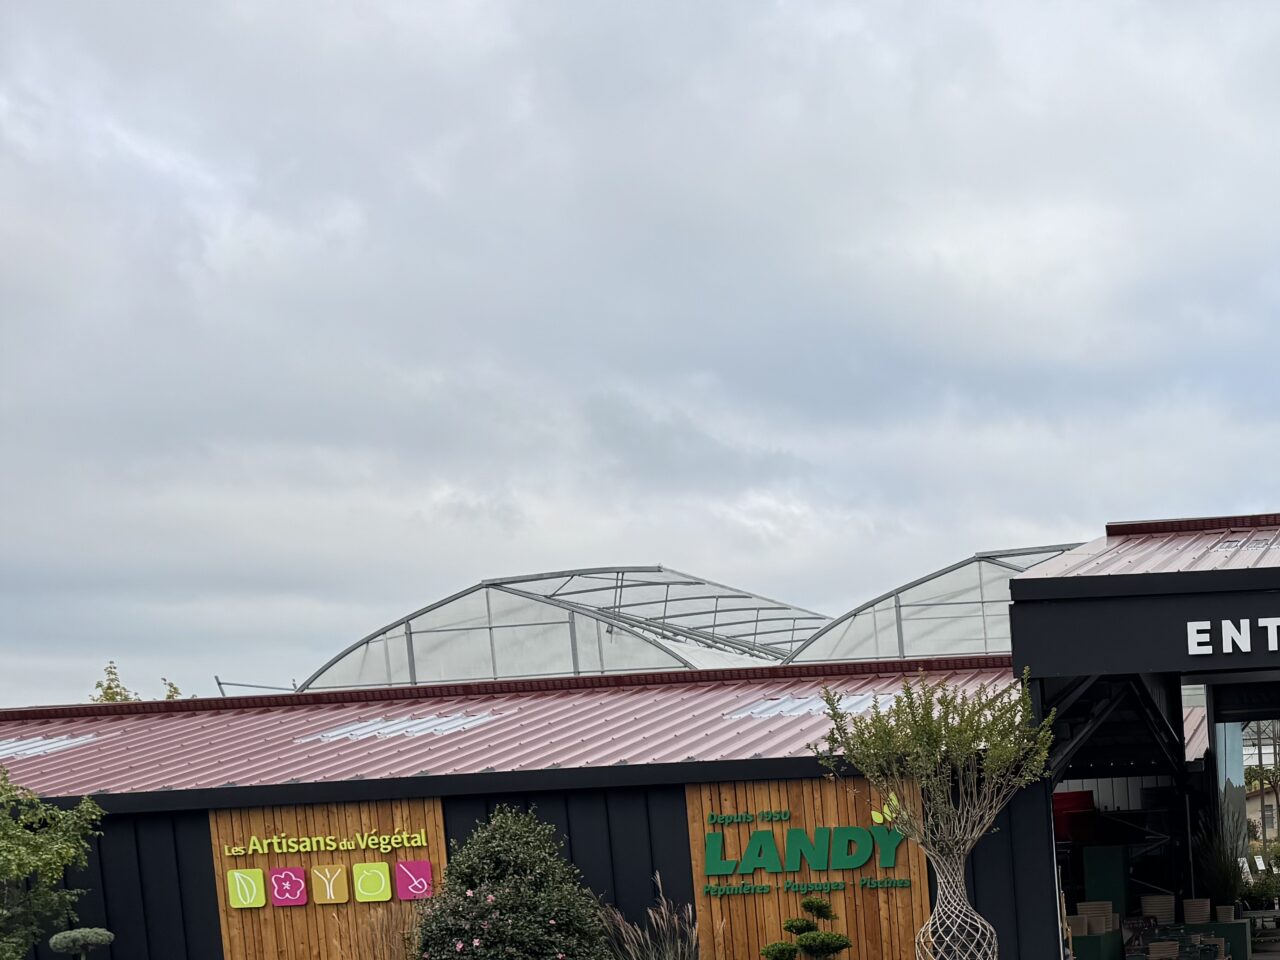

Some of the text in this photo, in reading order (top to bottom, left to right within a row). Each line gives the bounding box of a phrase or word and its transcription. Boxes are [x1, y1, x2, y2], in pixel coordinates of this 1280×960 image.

[707, 809, 791, 826] Depuis 1950
[224, 828, 428, 856] Les Artisans du Végétal
[704, 826, 906, 876] LANDY
[703, 881, 771, 898] Pépinières
[783, 879, 846, 895] Paysages
[859, 876, 911, 889] Piscines
